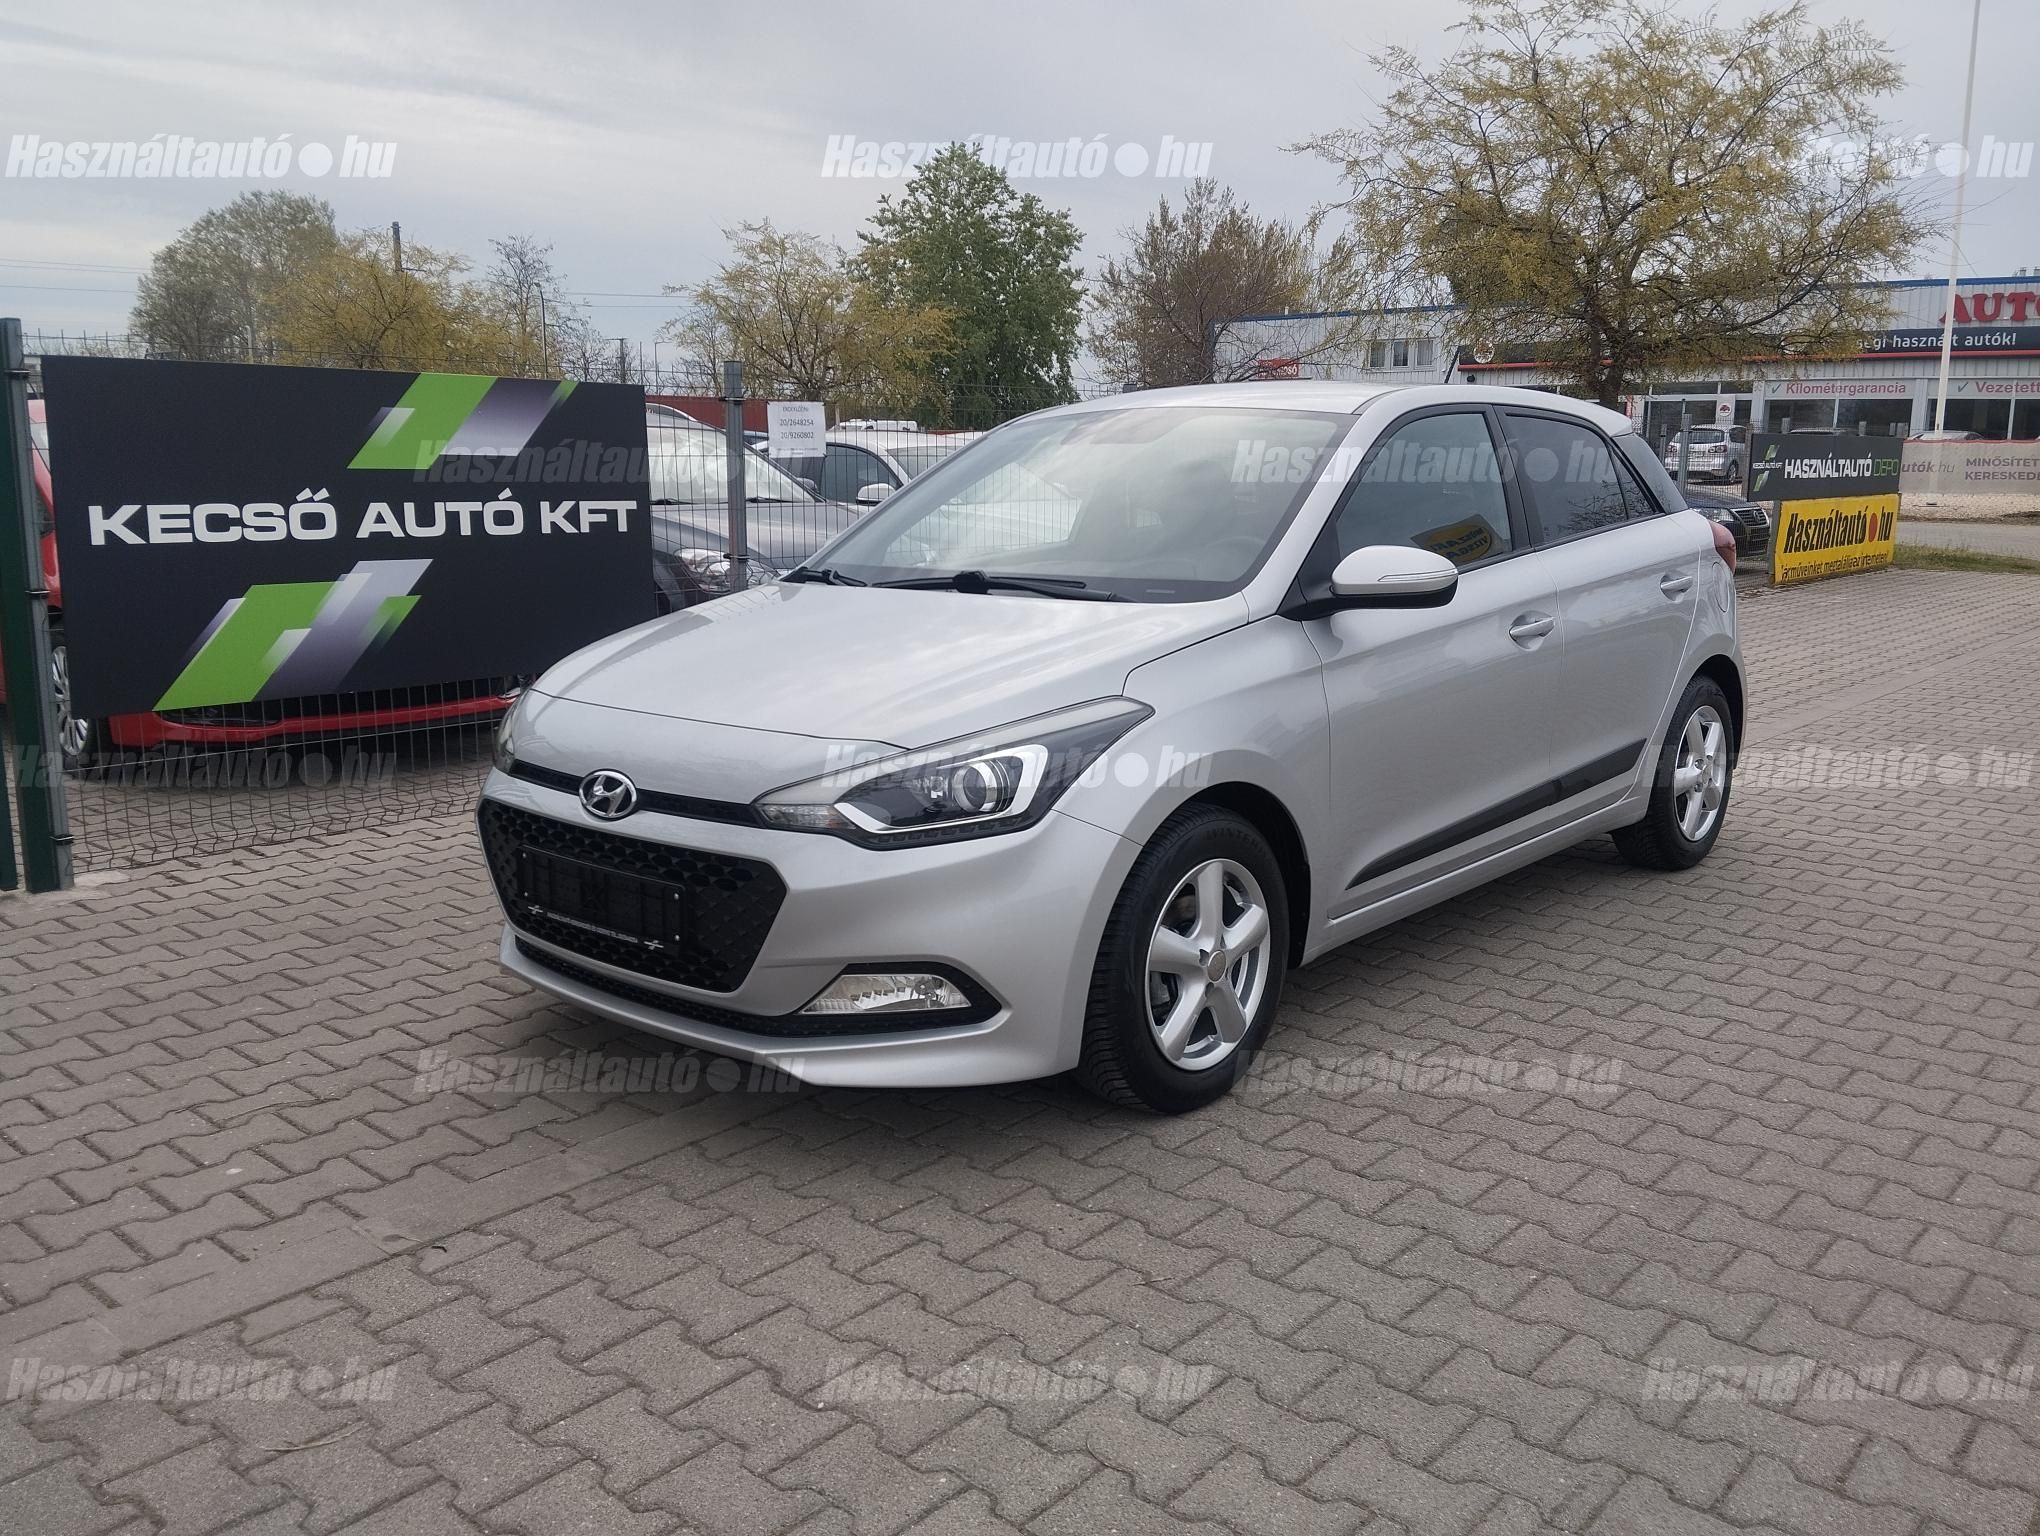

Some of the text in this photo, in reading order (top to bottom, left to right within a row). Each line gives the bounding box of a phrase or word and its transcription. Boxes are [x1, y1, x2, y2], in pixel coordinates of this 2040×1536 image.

[1940, 291, 2040, 323] AUT
[1893, 334, 1958, 348] hasznát
[1965, 333, 2017, 346] autók!
[1786, 383, 1906, 397] Kilométergarancia
[1784, 452, 1872, 479] HASZNÁLTAUTÓ
[1902, 460, 1955, 473] utók.hu
[88, 487, 637, 546] KECSŐ AUTÓ KFT
